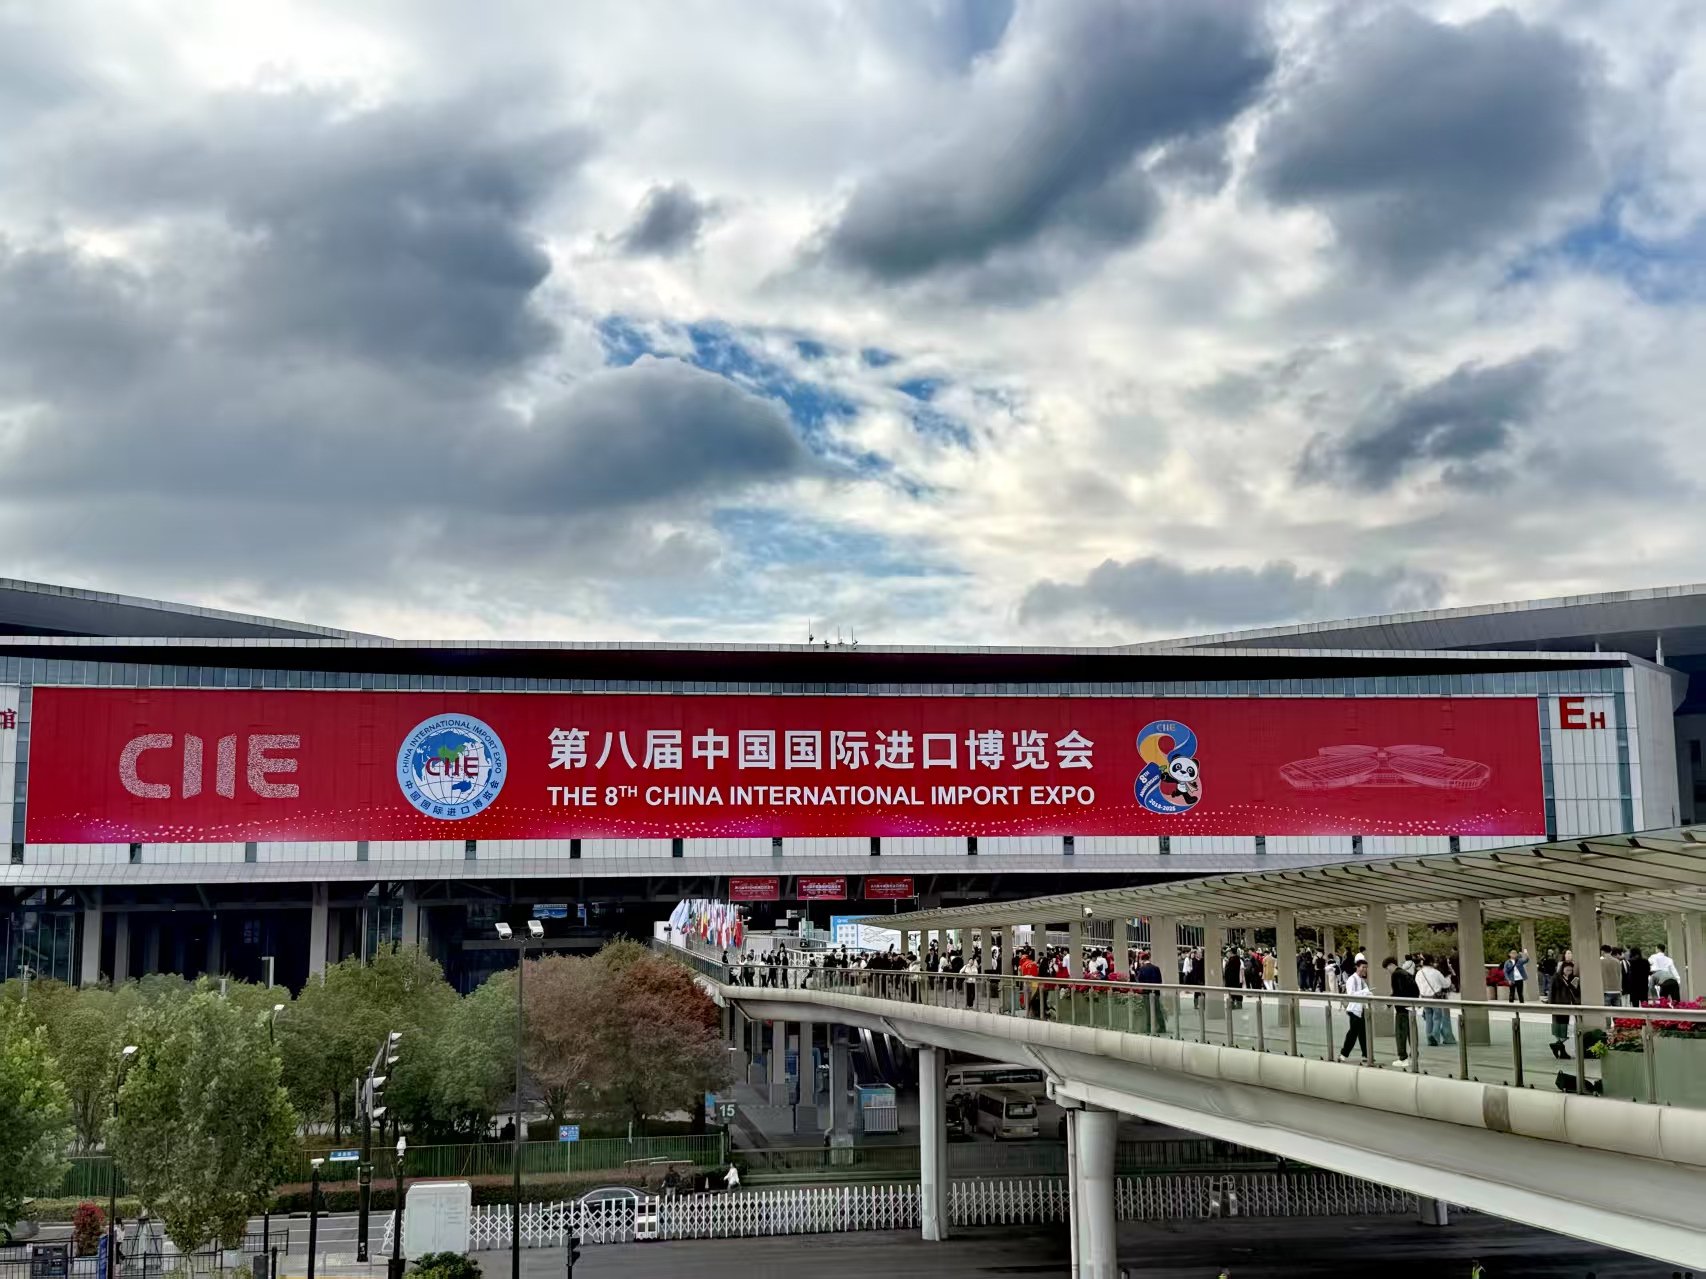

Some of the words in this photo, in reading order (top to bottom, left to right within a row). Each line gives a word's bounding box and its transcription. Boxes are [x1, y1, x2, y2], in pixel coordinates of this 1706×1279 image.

[402, 749, 412, 774] CHINA
[411, 719, 471, 748] INTERNATIONAL
[472, 725, 498, 750] IMPORT
[493, 751, 502, 774] EXPO
[548, 728, 1094, 770] 第八届中国国际进口博览会
[119, 733, 300, 799] CIIE
[425, 756, 480, 777] CIIE
[1139, 770, 1150, 784] 8TH
[405, 780, 500, 817] 中国国际进口博览会
[547, 786, 597, 805] THE
[605, 785, 638, 806] 8TH
[645, 786, 723, 805] CHINA
[730, 786, 924, 805] INTERNATIONAL
[931, 786, 1024, 805] IMPORT
[1030, 786, 1095, 805] EXPO
[719, 1104, 735, 1117] 15
